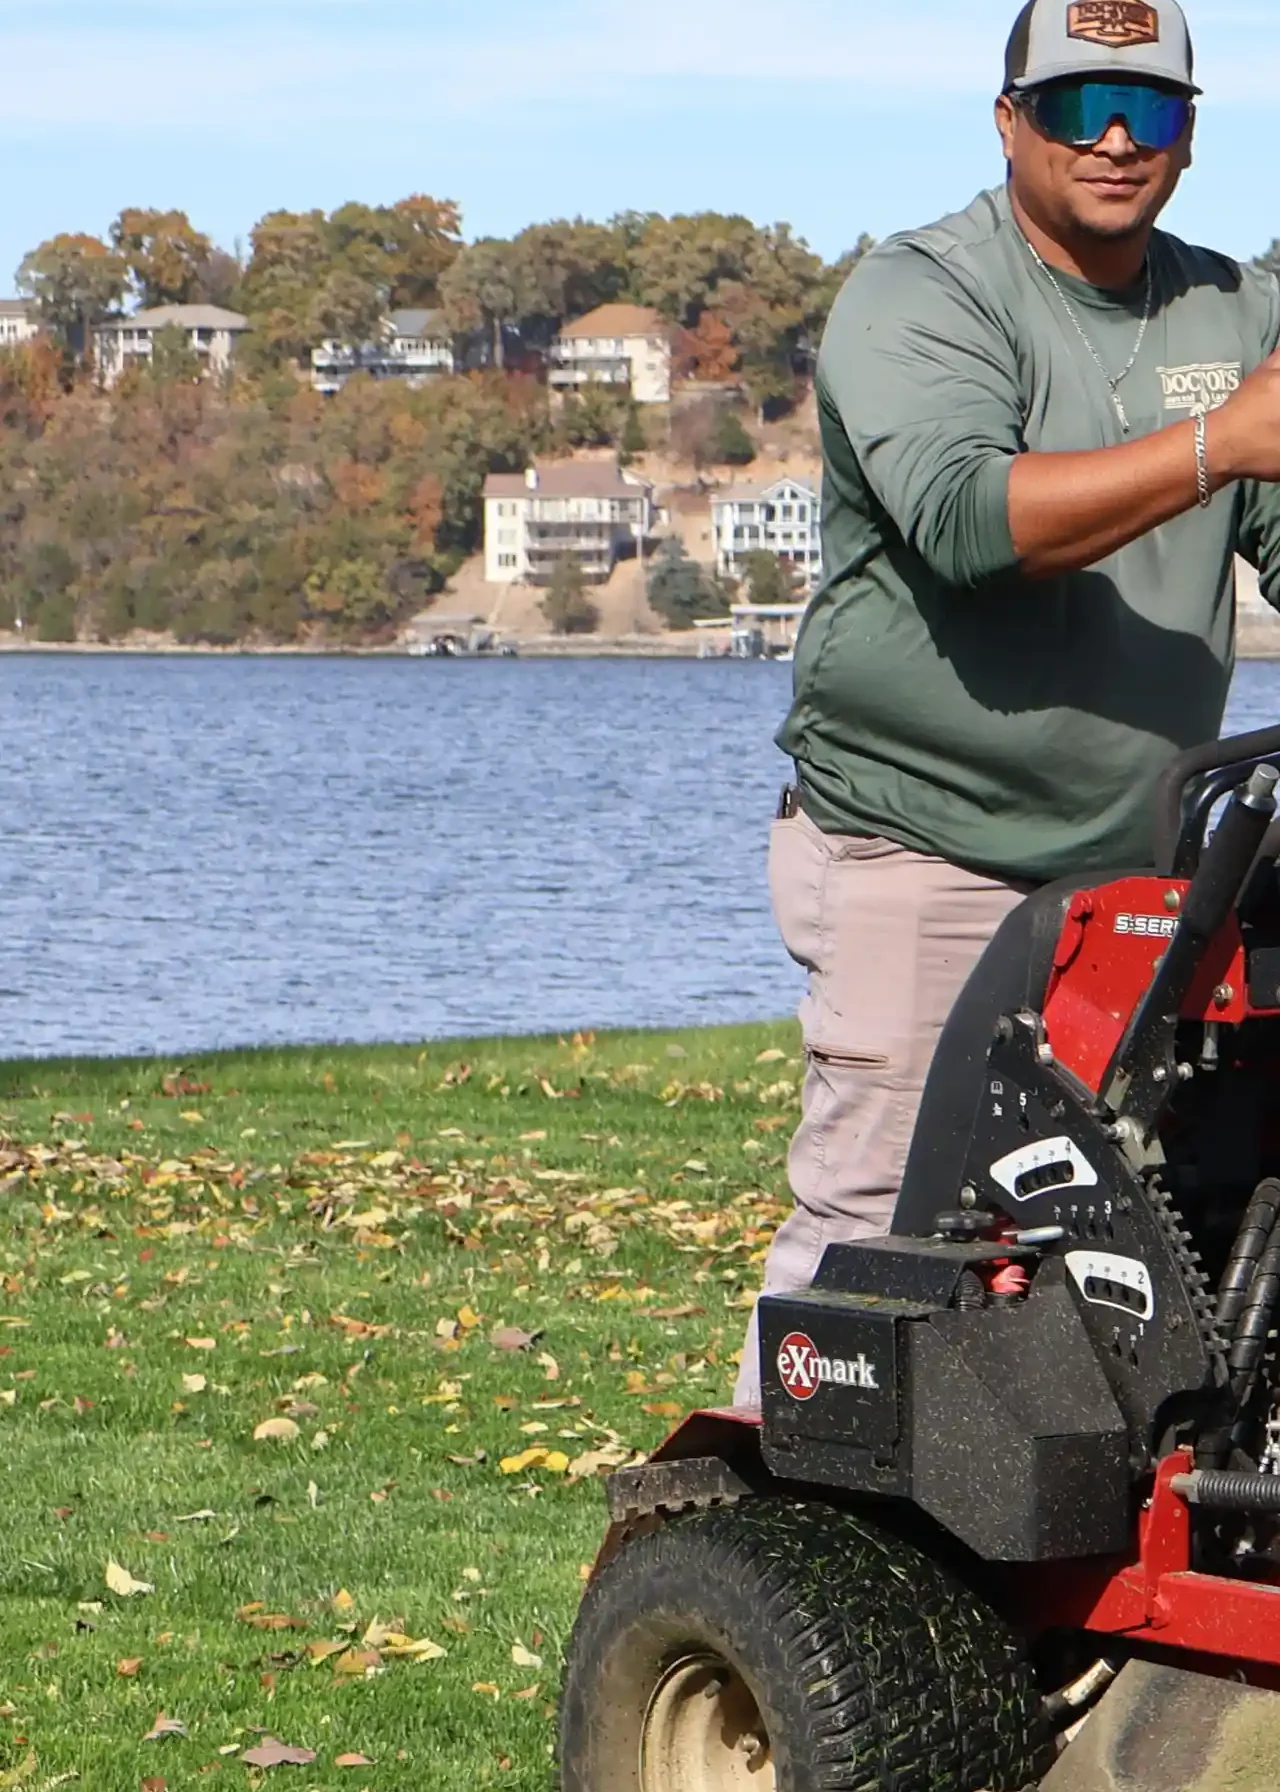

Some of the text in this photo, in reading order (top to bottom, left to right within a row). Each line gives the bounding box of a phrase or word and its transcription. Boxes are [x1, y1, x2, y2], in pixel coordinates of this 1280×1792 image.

[1019, 1092, 1027, 1106] 5
[1104, 1200, 1112, 1214] 3
[1138, 1271, 1145, 1284] 2
